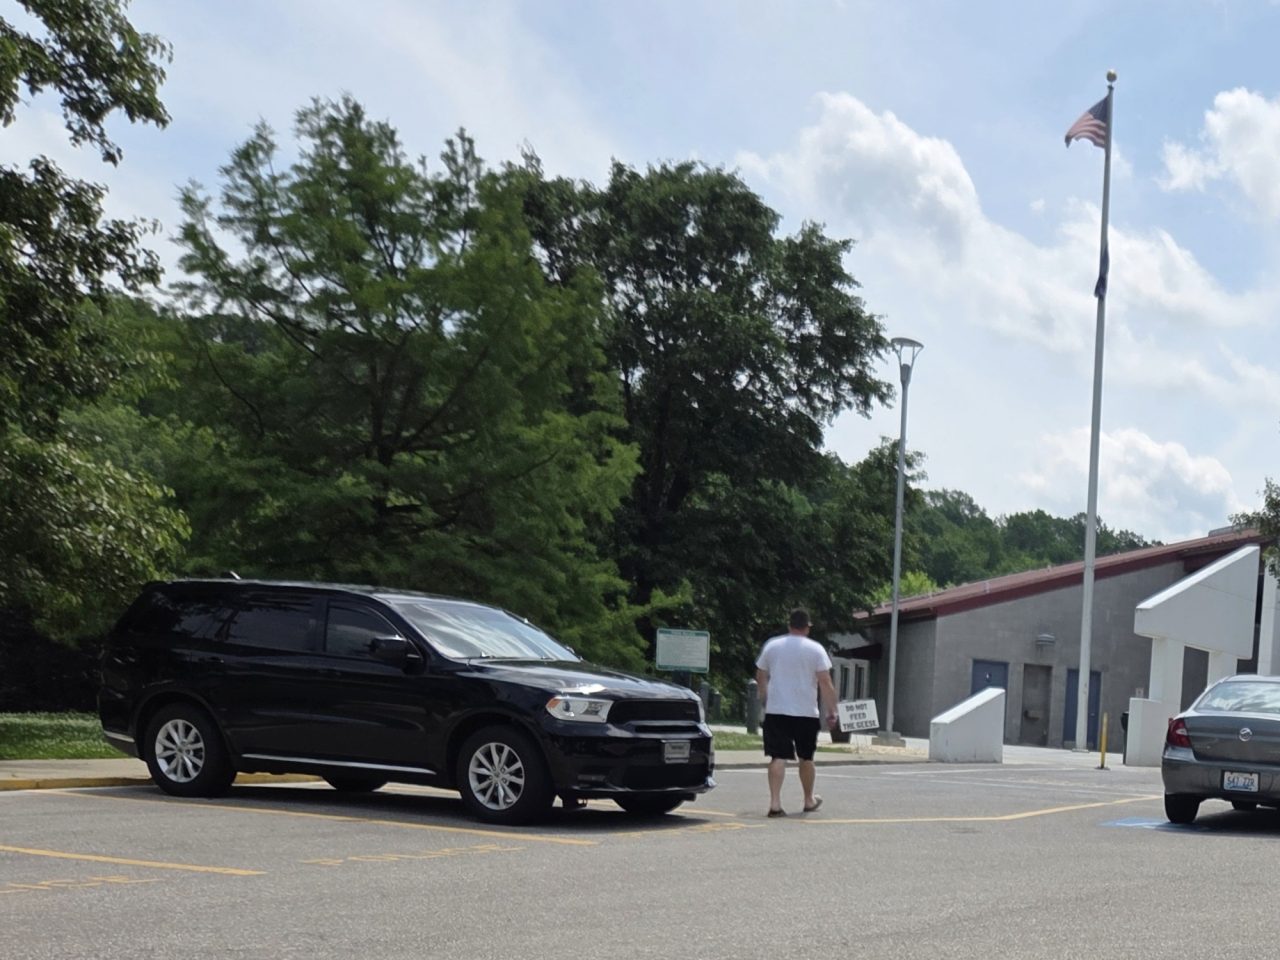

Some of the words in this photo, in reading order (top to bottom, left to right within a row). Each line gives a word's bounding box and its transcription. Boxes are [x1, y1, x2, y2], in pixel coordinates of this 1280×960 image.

[850, 712, 867, 720] FEED
[843, 722, 855, 730] THE
[856, 720, 877, 728] GEESE
